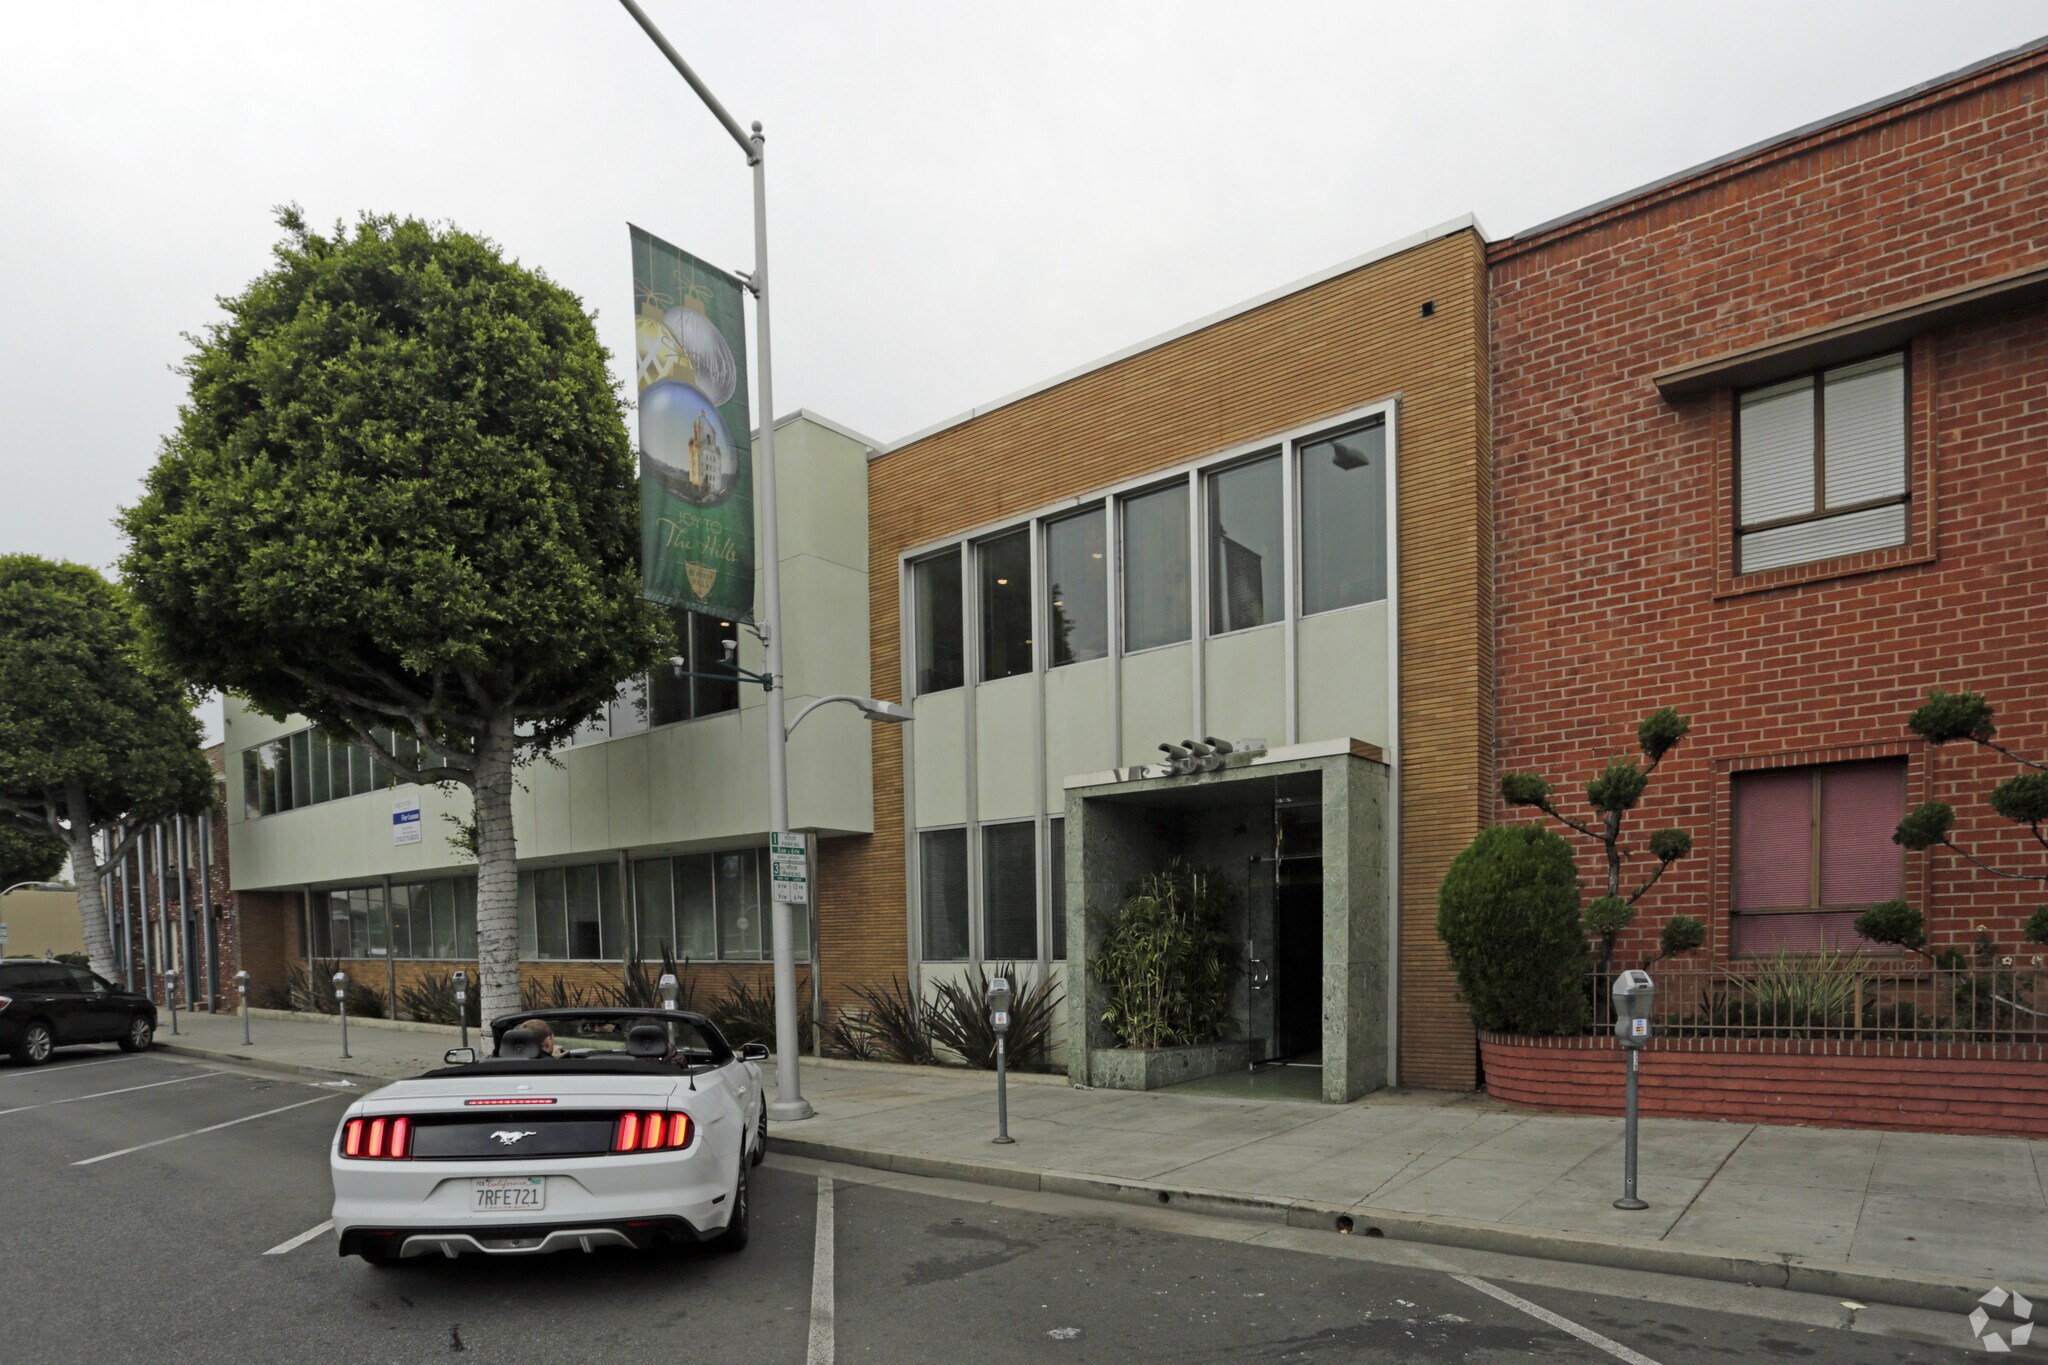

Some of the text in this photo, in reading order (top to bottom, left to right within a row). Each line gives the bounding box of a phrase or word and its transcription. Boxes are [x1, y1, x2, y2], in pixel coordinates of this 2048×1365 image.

[678, 511, 722, 534] JOY TO
[656, 517, 737, 562] The Hills
[487, 1178, 530, 1189] California
[476, 1188, 539, 1206] 7RFE721
